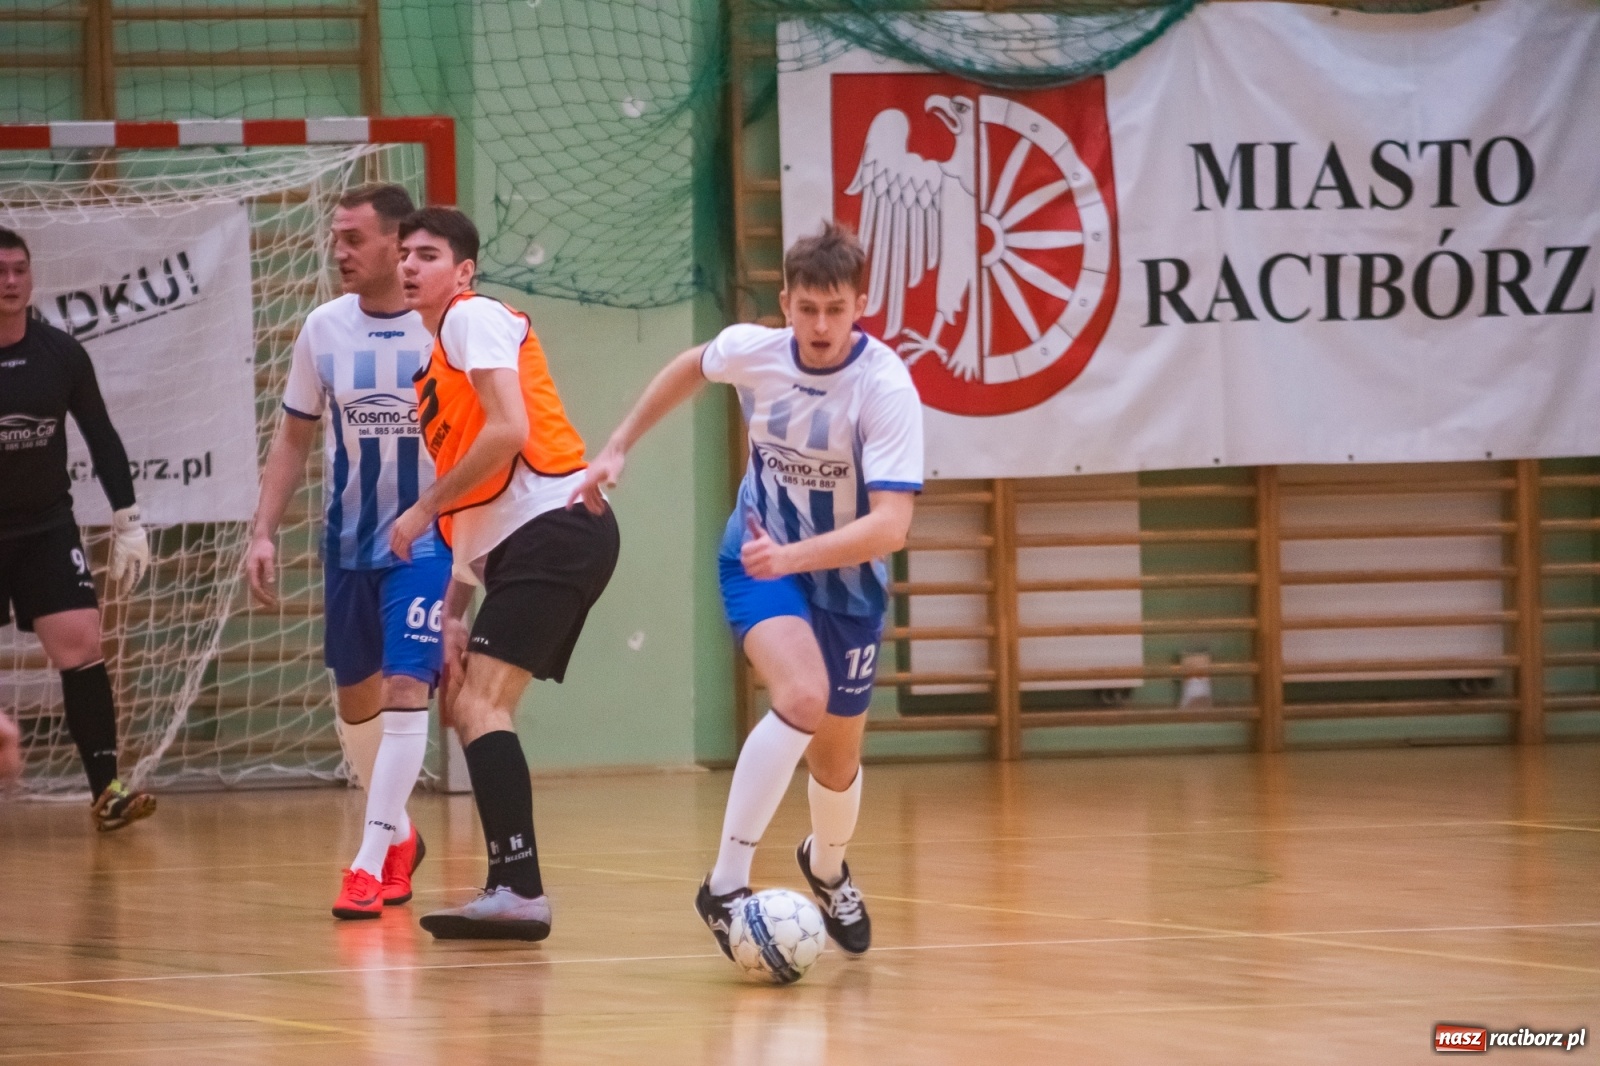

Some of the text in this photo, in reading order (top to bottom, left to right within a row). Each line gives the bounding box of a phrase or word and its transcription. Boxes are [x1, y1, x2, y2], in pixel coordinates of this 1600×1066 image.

[1187, 135, 1536, 212] MIASTO
[1137, 227, 1594, 327] RACIBÓRZ
[368, 330, 405, 339] regio
[346, 408, 419, 424] Kosmo-C
[0, 424, 56, 442] smo-Car
[762, 452, 850, 477] osmo-Car
[405, 596, 443, 632] 66
[845, 644, 876, 680] 12
